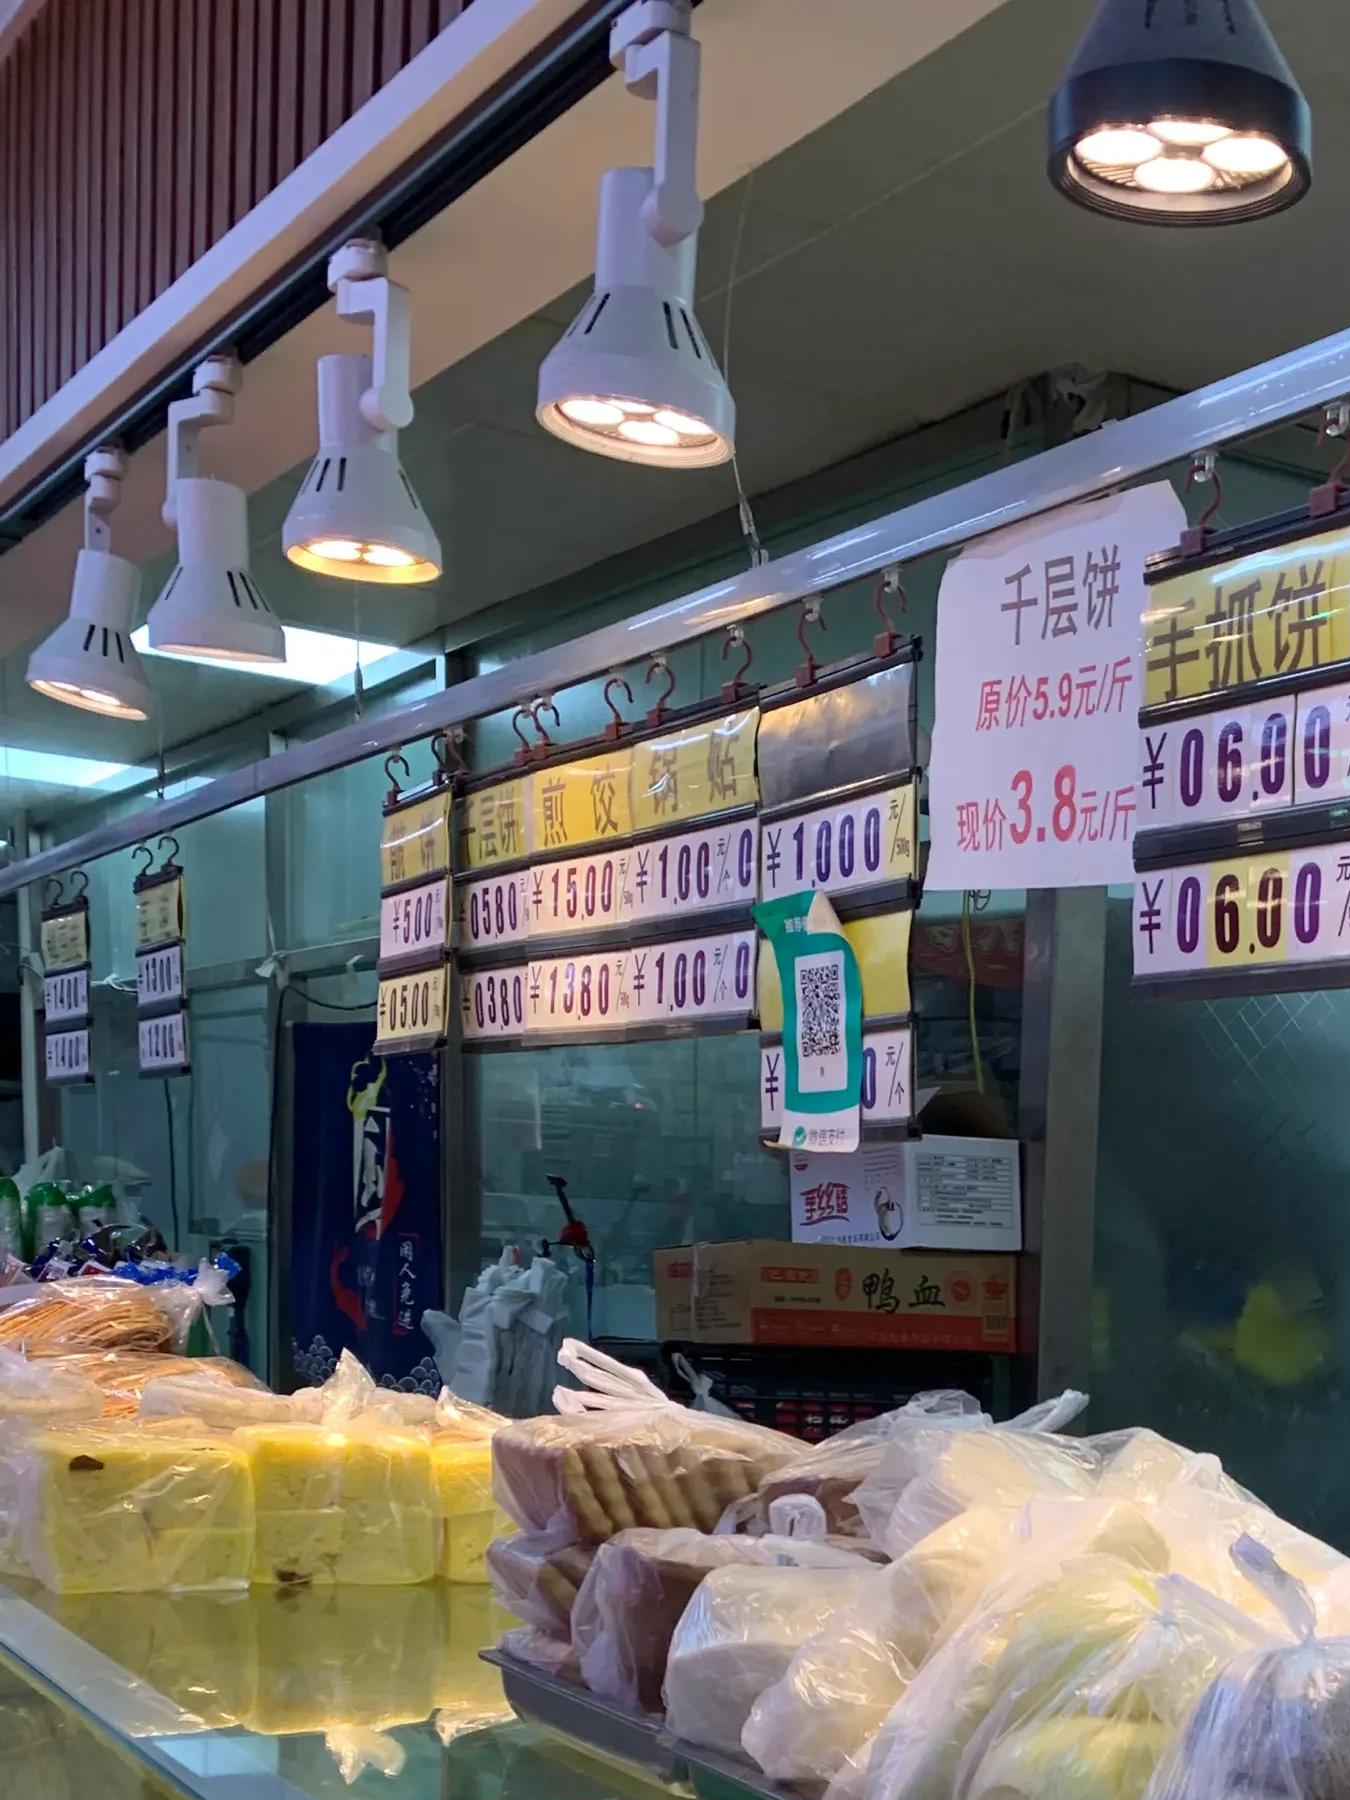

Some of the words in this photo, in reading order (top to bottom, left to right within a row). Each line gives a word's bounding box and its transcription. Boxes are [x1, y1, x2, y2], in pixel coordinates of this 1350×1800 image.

[1001, 543, 1122, 646] 千层饼
[1146, 557, 1333, 700] 手抓饼
[974, 655, 1133, 732] 原价5.9元/斤
[542, 764, 619, 847] 煎饺
[956, 764, 1137, 853] 现价3.8元/斤
[863, 1268, 946, 1313] 鸭血
